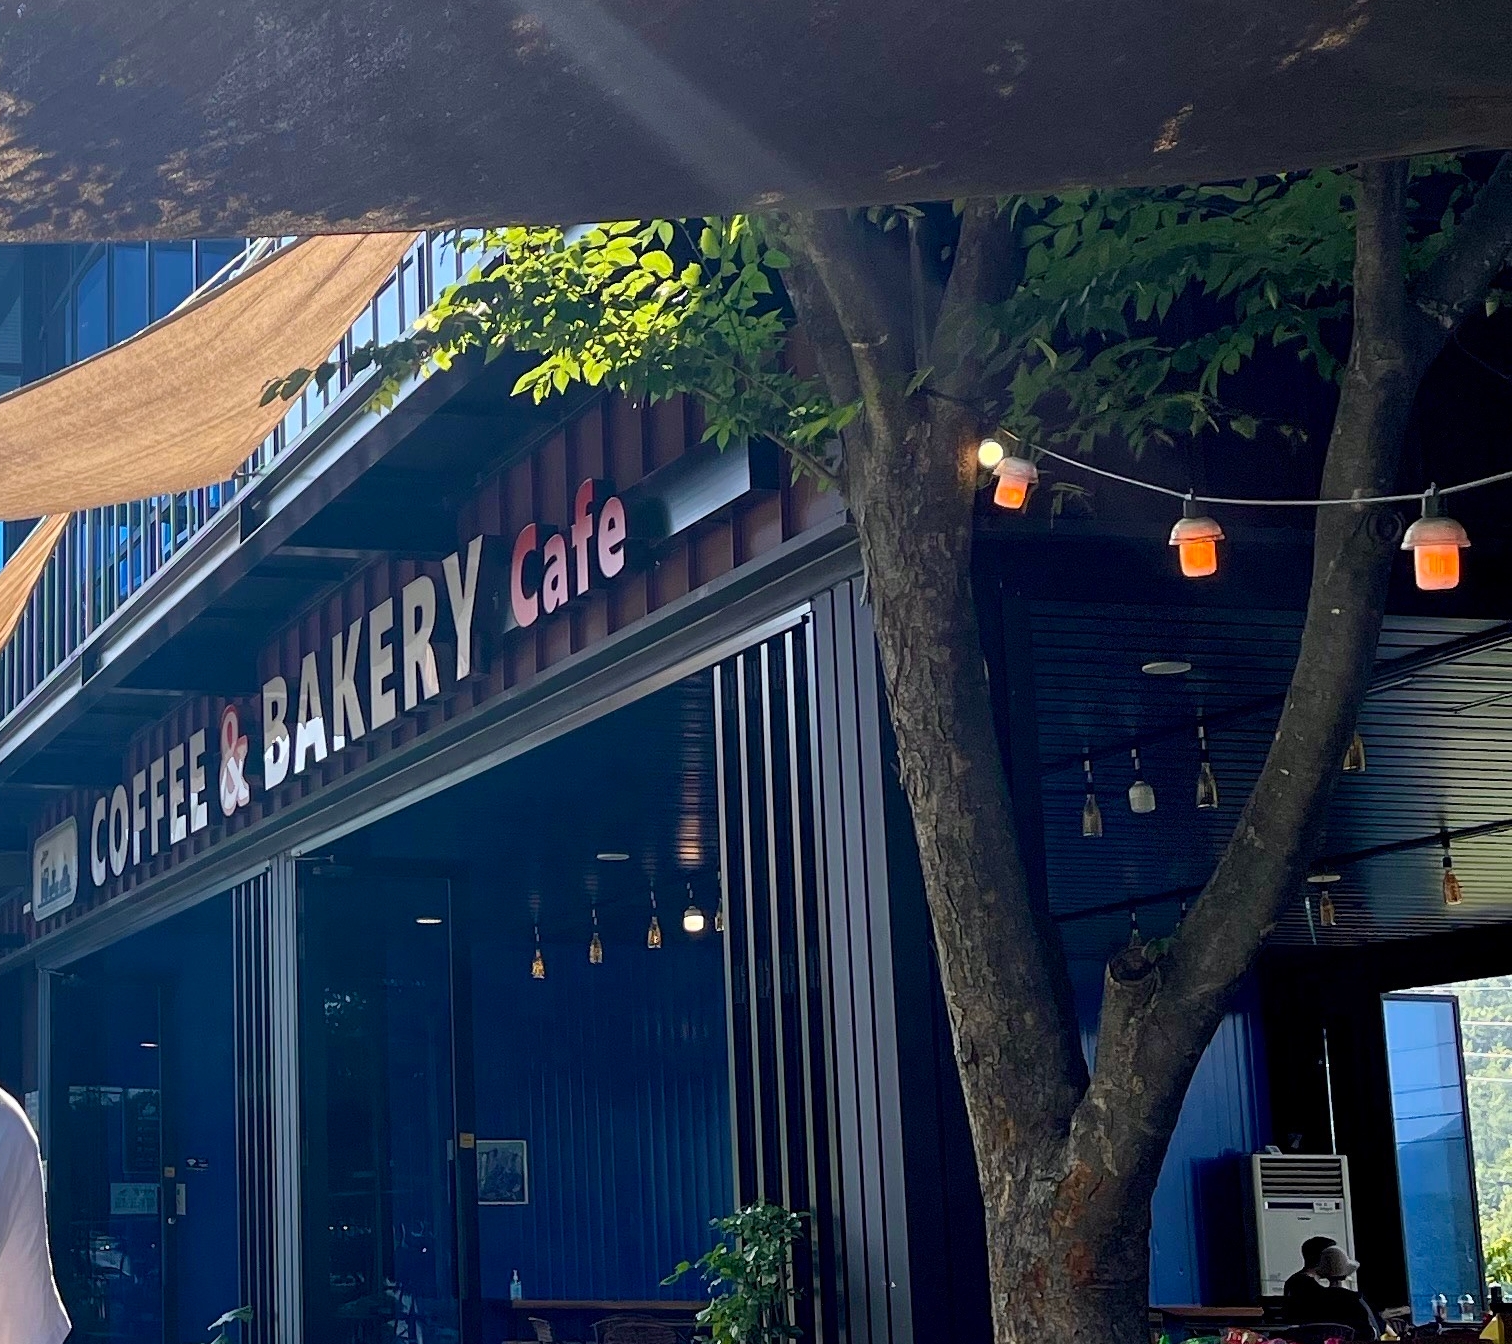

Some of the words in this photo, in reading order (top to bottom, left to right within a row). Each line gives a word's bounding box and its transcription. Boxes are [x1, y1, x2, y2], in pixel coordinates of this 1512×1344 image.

[91, 729, 208, 888] COFFEE
[219, 704, 252, 817] &
[262, 534, 486, 792] BAKERY
[510, 478, 628, 629] Cafe
